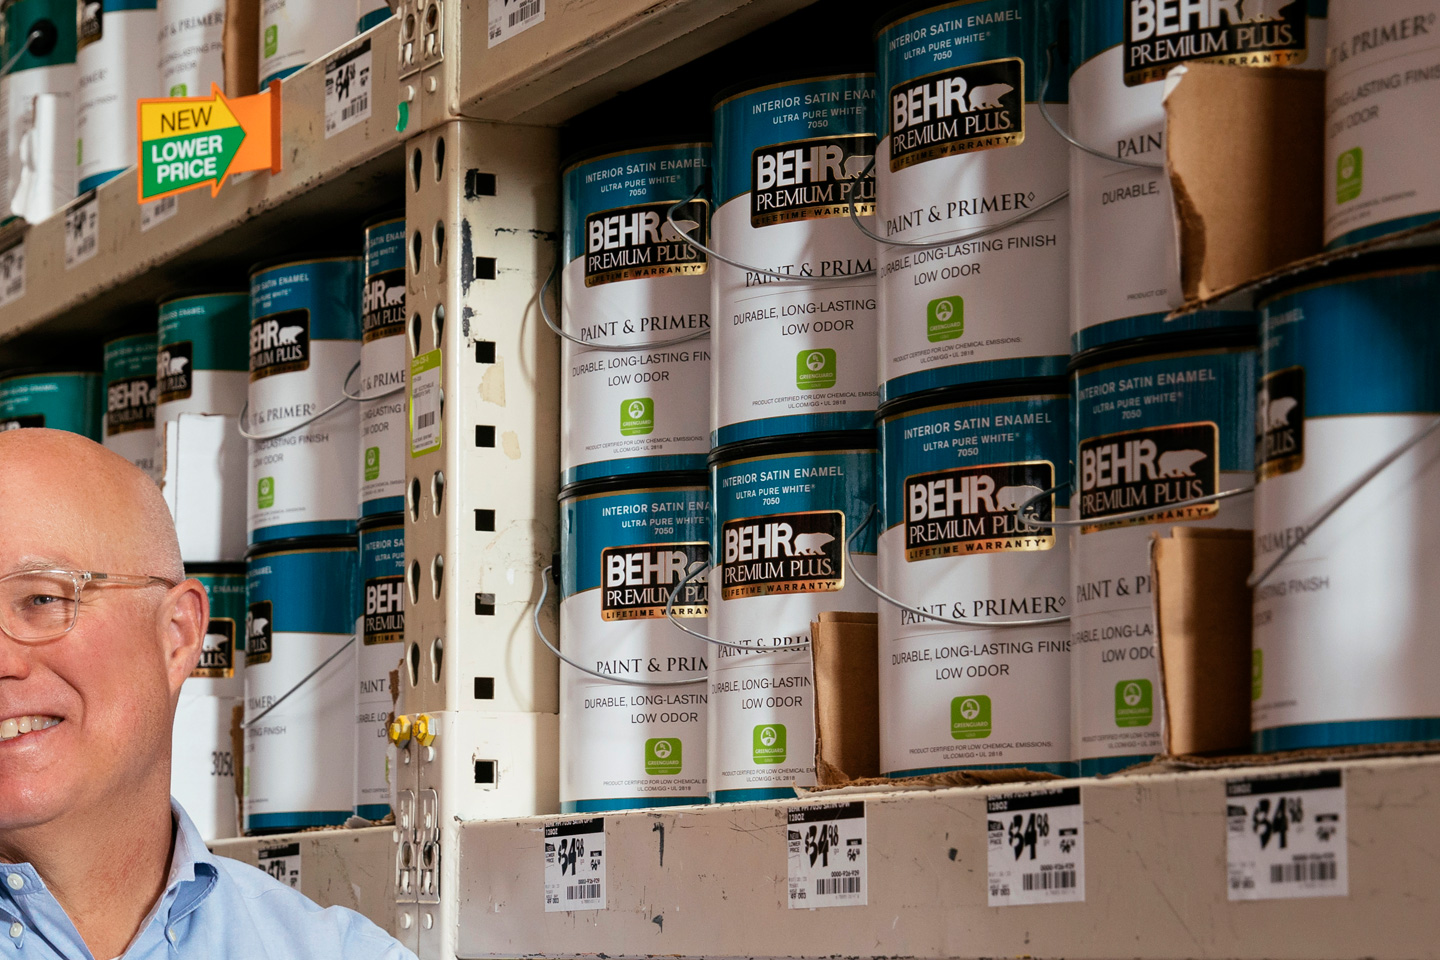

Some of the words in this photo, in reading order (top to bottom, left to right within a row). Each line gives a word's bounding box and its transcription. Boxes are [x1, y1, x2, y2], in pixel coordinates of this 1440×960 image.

[889, 28, 926, 52] INTERIOR
[930, 19, 962, 35] SATIN
[967, 10, 1022, 27] ENAMEL
[904, 47, 926, 60] ULTRA
[929, 39, 951, 52] PURE
[933, 50, 952, 61] 7050
[1130, 30, 1227, 67] PREMIUM
[1237, 25, 1293, 49] PLUS
[752, 97, 800, 114] INTERIOR
[805, 93, 839, 104] SATIN
[893, 77, 969, 132] BEHR
[161, 106, 212, 133] NEW
[893, 118, 958, 154] PREMIUM
[965, 111, 1011, 135] PLUS
[152, 135, 222, 163] LOWER
[157, 157, 217, 184] PRICE
[586, 168, 623, 183] INTERIOR
[661, 159, 707, 170] ENAMEL
[757, 145, 845, 191] BEHR
[757, 184, 833, 212] PREMIUM
[1102, 182, 1160, 205] DURABLE,
[589, 211, 660, 253] BEHR
[887, 209, 923, 236] PAINT
[928, 206, 942, 222] &
[589, 247, 651, 272] PREMIUM
[657, 244, 696, 262] PLUS
[914, 239, 1003, 265] LONG-LASTING
[1008, 235, 1056, 249] FINISH
[914, 270, 938, 285] LOW
[941, 263, 980, 280] ODOR
[782, 299, 876, 317] LONG-LASTING
[581, 321, 618, 341] PAINT
[813, 320, 853, 332] ODOR
[608, 352, 689, 369] LONG-LASTING
[634, 371, 669, 384] ODOR
[1119, 376, 1152, 391] SATIN
[1157, 369, 1215, 385] ENAMEL
[905, 423, 950, 439] INTERIOR
[954, 418, 989, 431] SATIN
[995, 413, 1052, 426] ENAMEL
[723, 473, 757, 488] INTERIOR
[760, 470, 789, 482] SATIN
[794, 466, 844, 478] ENAMEL
[1083, 439, 1159, 491] BEHR
[603, 504, 647, 516] INTERIOR
[652, 502, 684, 513] SATIN
[910, 475, 996, 522] BEHR
[1083, 485, 1147, 515] PREMIUM
[1155, 479, 1203, 504] PLUS
[910, 518, 985, 544] PREMIUM
[992, 513, 1040, 535] PLUS
[725, 522, 793, 564] BEHR
[607, 551, 687, 587] BEHR
[725, 561, 784, 584] PREMIUM
[791, 558, 831, 576] PLUS
[607, 588, 678, 606] PREMIUM
[1077, 579, 1111, 603] PAINT
[892, 649, 932, 665] DURABLE,
[936, 642, 1033, 659] LONG-LASTING
[597, 659, 642, 674] PAINT
[936, 668, 963, 680] LOW
[967, 664, 1009, 677] ODOR
[766, 696, 802, 707] ODOR
[660, 712, 698, 723] ODOR
